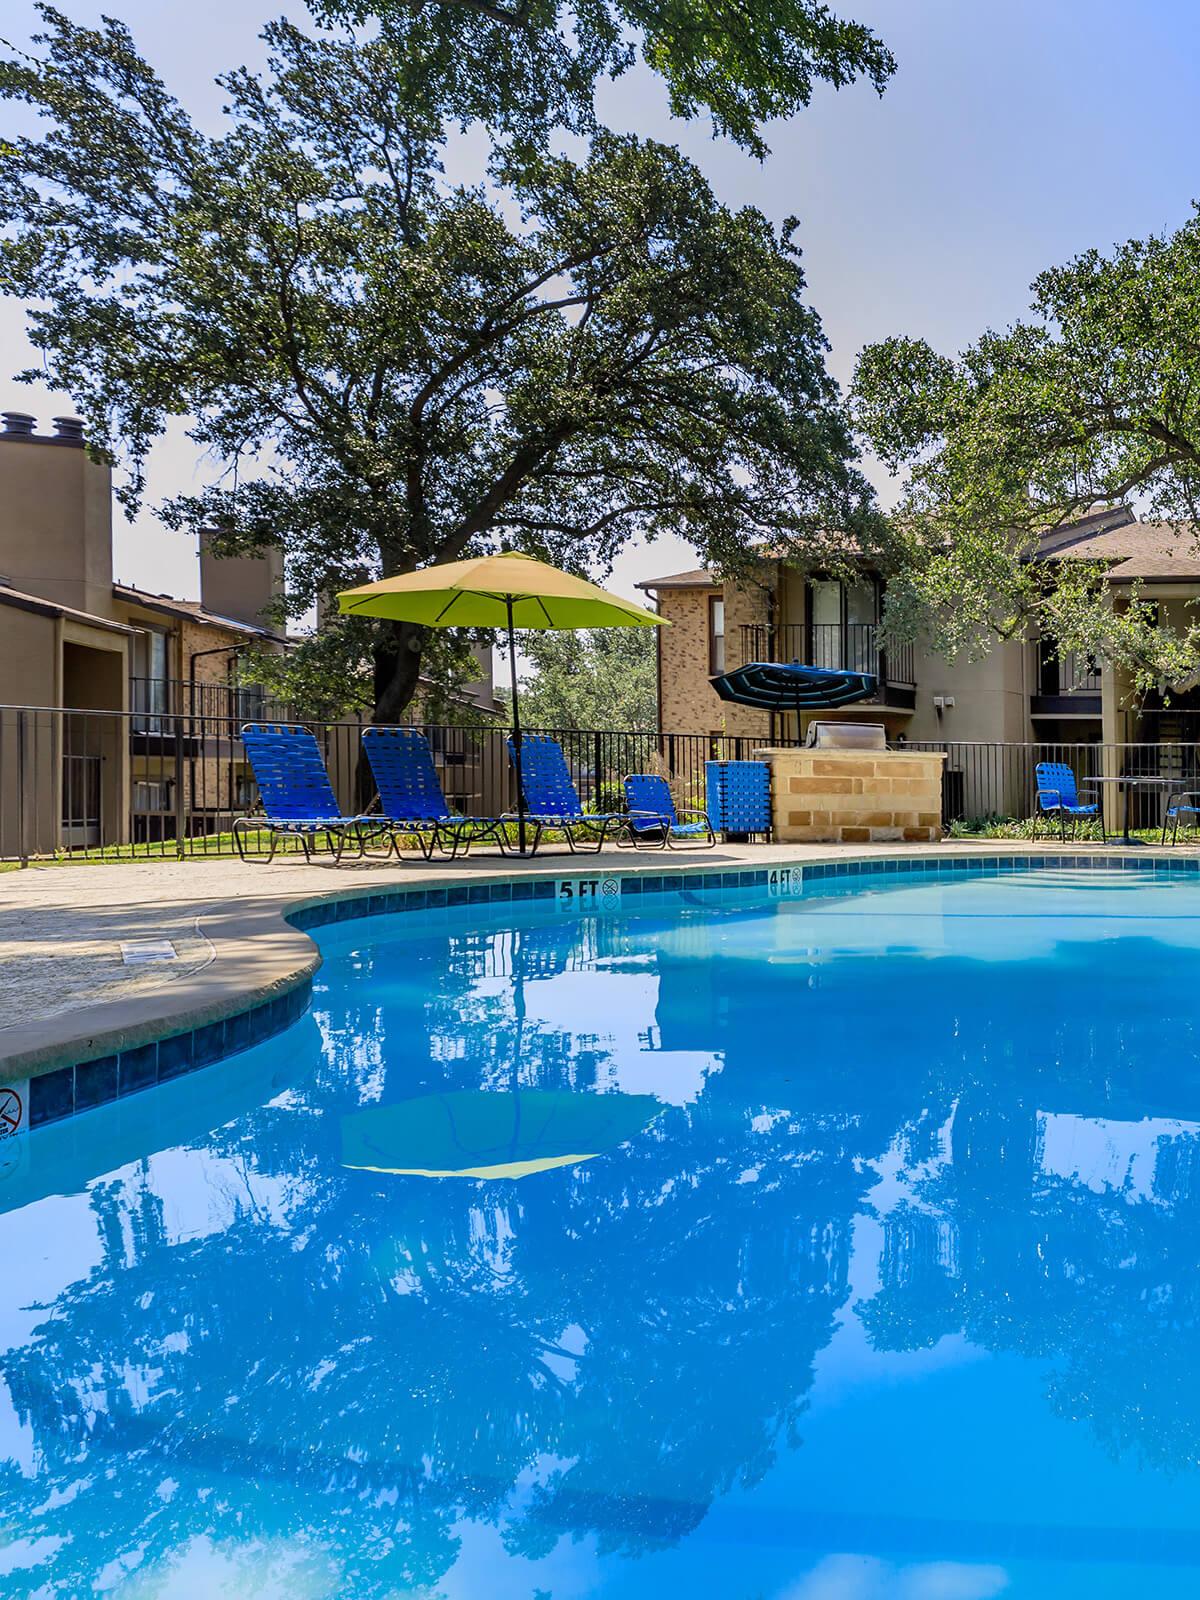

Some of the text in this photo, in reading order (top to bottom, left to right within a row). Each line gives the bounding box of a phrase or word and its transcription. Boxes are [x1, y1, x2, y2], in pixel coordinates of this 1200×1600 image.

[770, 869, 790, 883] 4 FT
[560, 880, 599, 899] 5 FT
